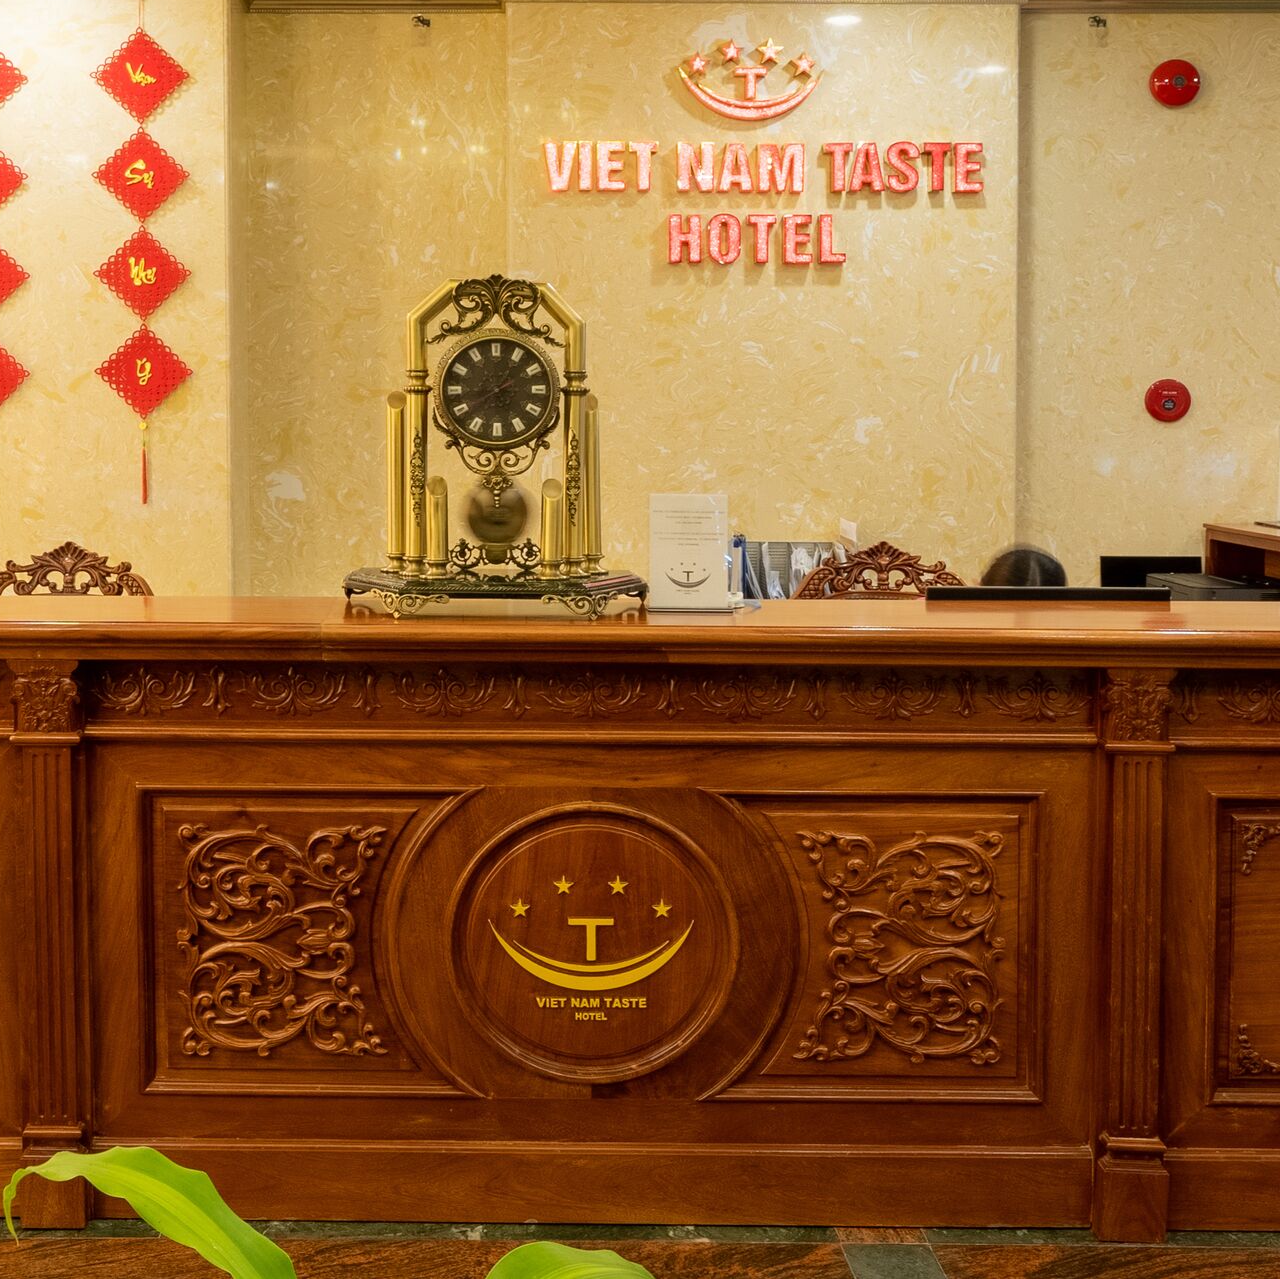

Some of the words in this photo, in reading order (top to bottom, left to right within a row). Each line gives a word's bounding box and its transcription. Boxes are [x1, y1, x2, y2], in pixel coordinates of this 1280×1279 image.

[543, 140, 659, 193] VIET
[676, 140, 806, 194] NAM
[822, 140, 985, 194] TASTE
[667, 212, 847, 265] HOTEL
[535, 996, 568, 1009] VIET
[571, 997, 601, 1009] NAM
[603, 996, 648, 1009] TASTE
[574, 1011, 608, 1022] HOTEL
